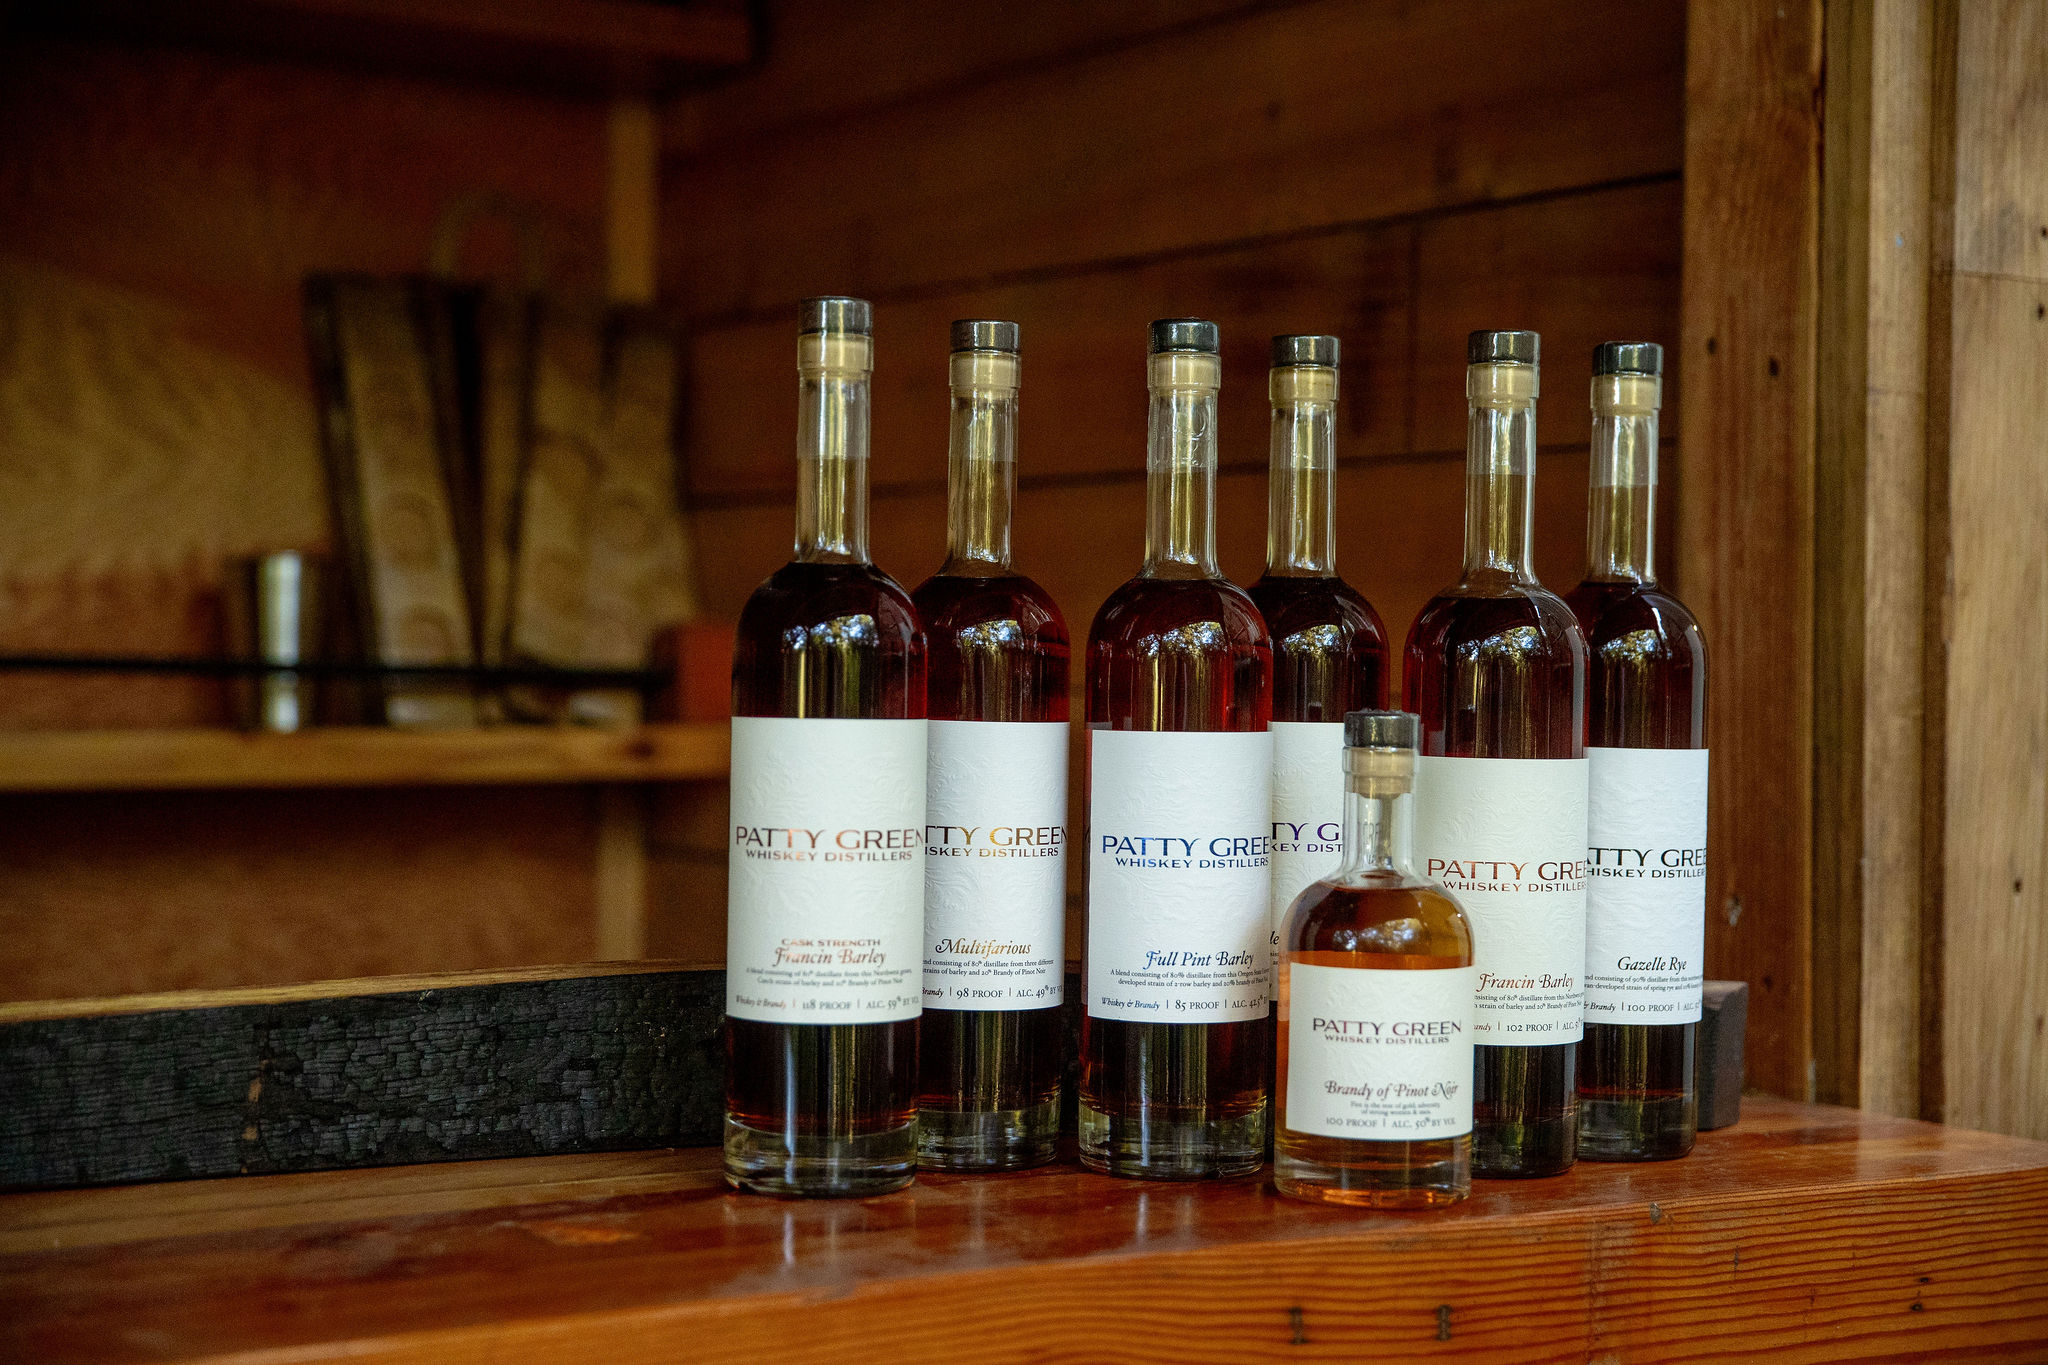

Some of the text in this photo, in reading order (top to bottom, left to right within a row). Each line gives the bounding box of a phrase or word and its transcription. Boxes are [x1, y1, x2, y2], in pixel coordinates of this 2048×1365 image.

[736, 826, 924, 850] PATTY GREEN
[925, 825, 981, 845] TTY
[925, 846, 1059, 858] ISKEY DISTILLERS
[1102, 835, 1271, 857] PATTY GREE
[746, 849, 912, 862] WHISKEY DISTILLERS
[1587, 847, 1707, 868] TTY GREE
[1115, 857, 1193, 869] WHISKEY
[1427, 858, 1587, 881] PATTY GREE
[1587, 867, 1705, 878] HISKEY DISTILLER
[1442, 880, 1522, 892] WHISKEY
[781, 939, 881, 947] CASK STRENGTH
[935, 938, 1032, 960] Multifarious
[772, 947, 886, 968] Francin Barley
[1143, 950, 1254, 970] Full Pint Barley
[932, 960, 962, 968] consisting
[1617, 956, 1687, 975] Gazelle Rye
[993, 969, 1013, 977] Brandy
[1131, 971, 1160, 979] consisting
[1185, 971, 1212, 979] distillate
[1594, 975, 1624, 983] consisting
[1118, 978, 1146, 987] developed
[1193, 980, 1210, 988] barley
[1475, 973, 1575, 992] Francin Barley
[956, 987, 969, 1000] 98
[972, 989, 1003, 998] PROOF
[1016, 989, 1034, 998] ALC.
[819, 1000, 851, 1010] PROOF
[1101, 997, 1125, 1009] Whiskey
[1134, 1000, 1160, 1012] Brandy
[1175, 999, 1187, 1012] 85
[1189, 1001, 1220, 1010] PROOF
[1506, 1003, 1524, 1011] barley
[1590, 1002, 1616, 1013] Brandy
[1627, 1004, 1646, 1012] 100
[1648, 1004, 1674, 1012] PROOF
[1313, 1017, 1462, 1037] PATTY GREEN
[1473, 1022, 1491, 1032] andy
[1507, 1024, 1523, 1032] 102
[1525, 1023, 1553, 1032] PROOF
[1324, 1034, 1450, 1045] WHISKEY DISTILLERS
[1324, 1080, 1459, 1101] Brandy of Pinot Noir
[1326, 1117, 1343, 1126] 100
[1346, 1118, 1377, 1128] PROOF
